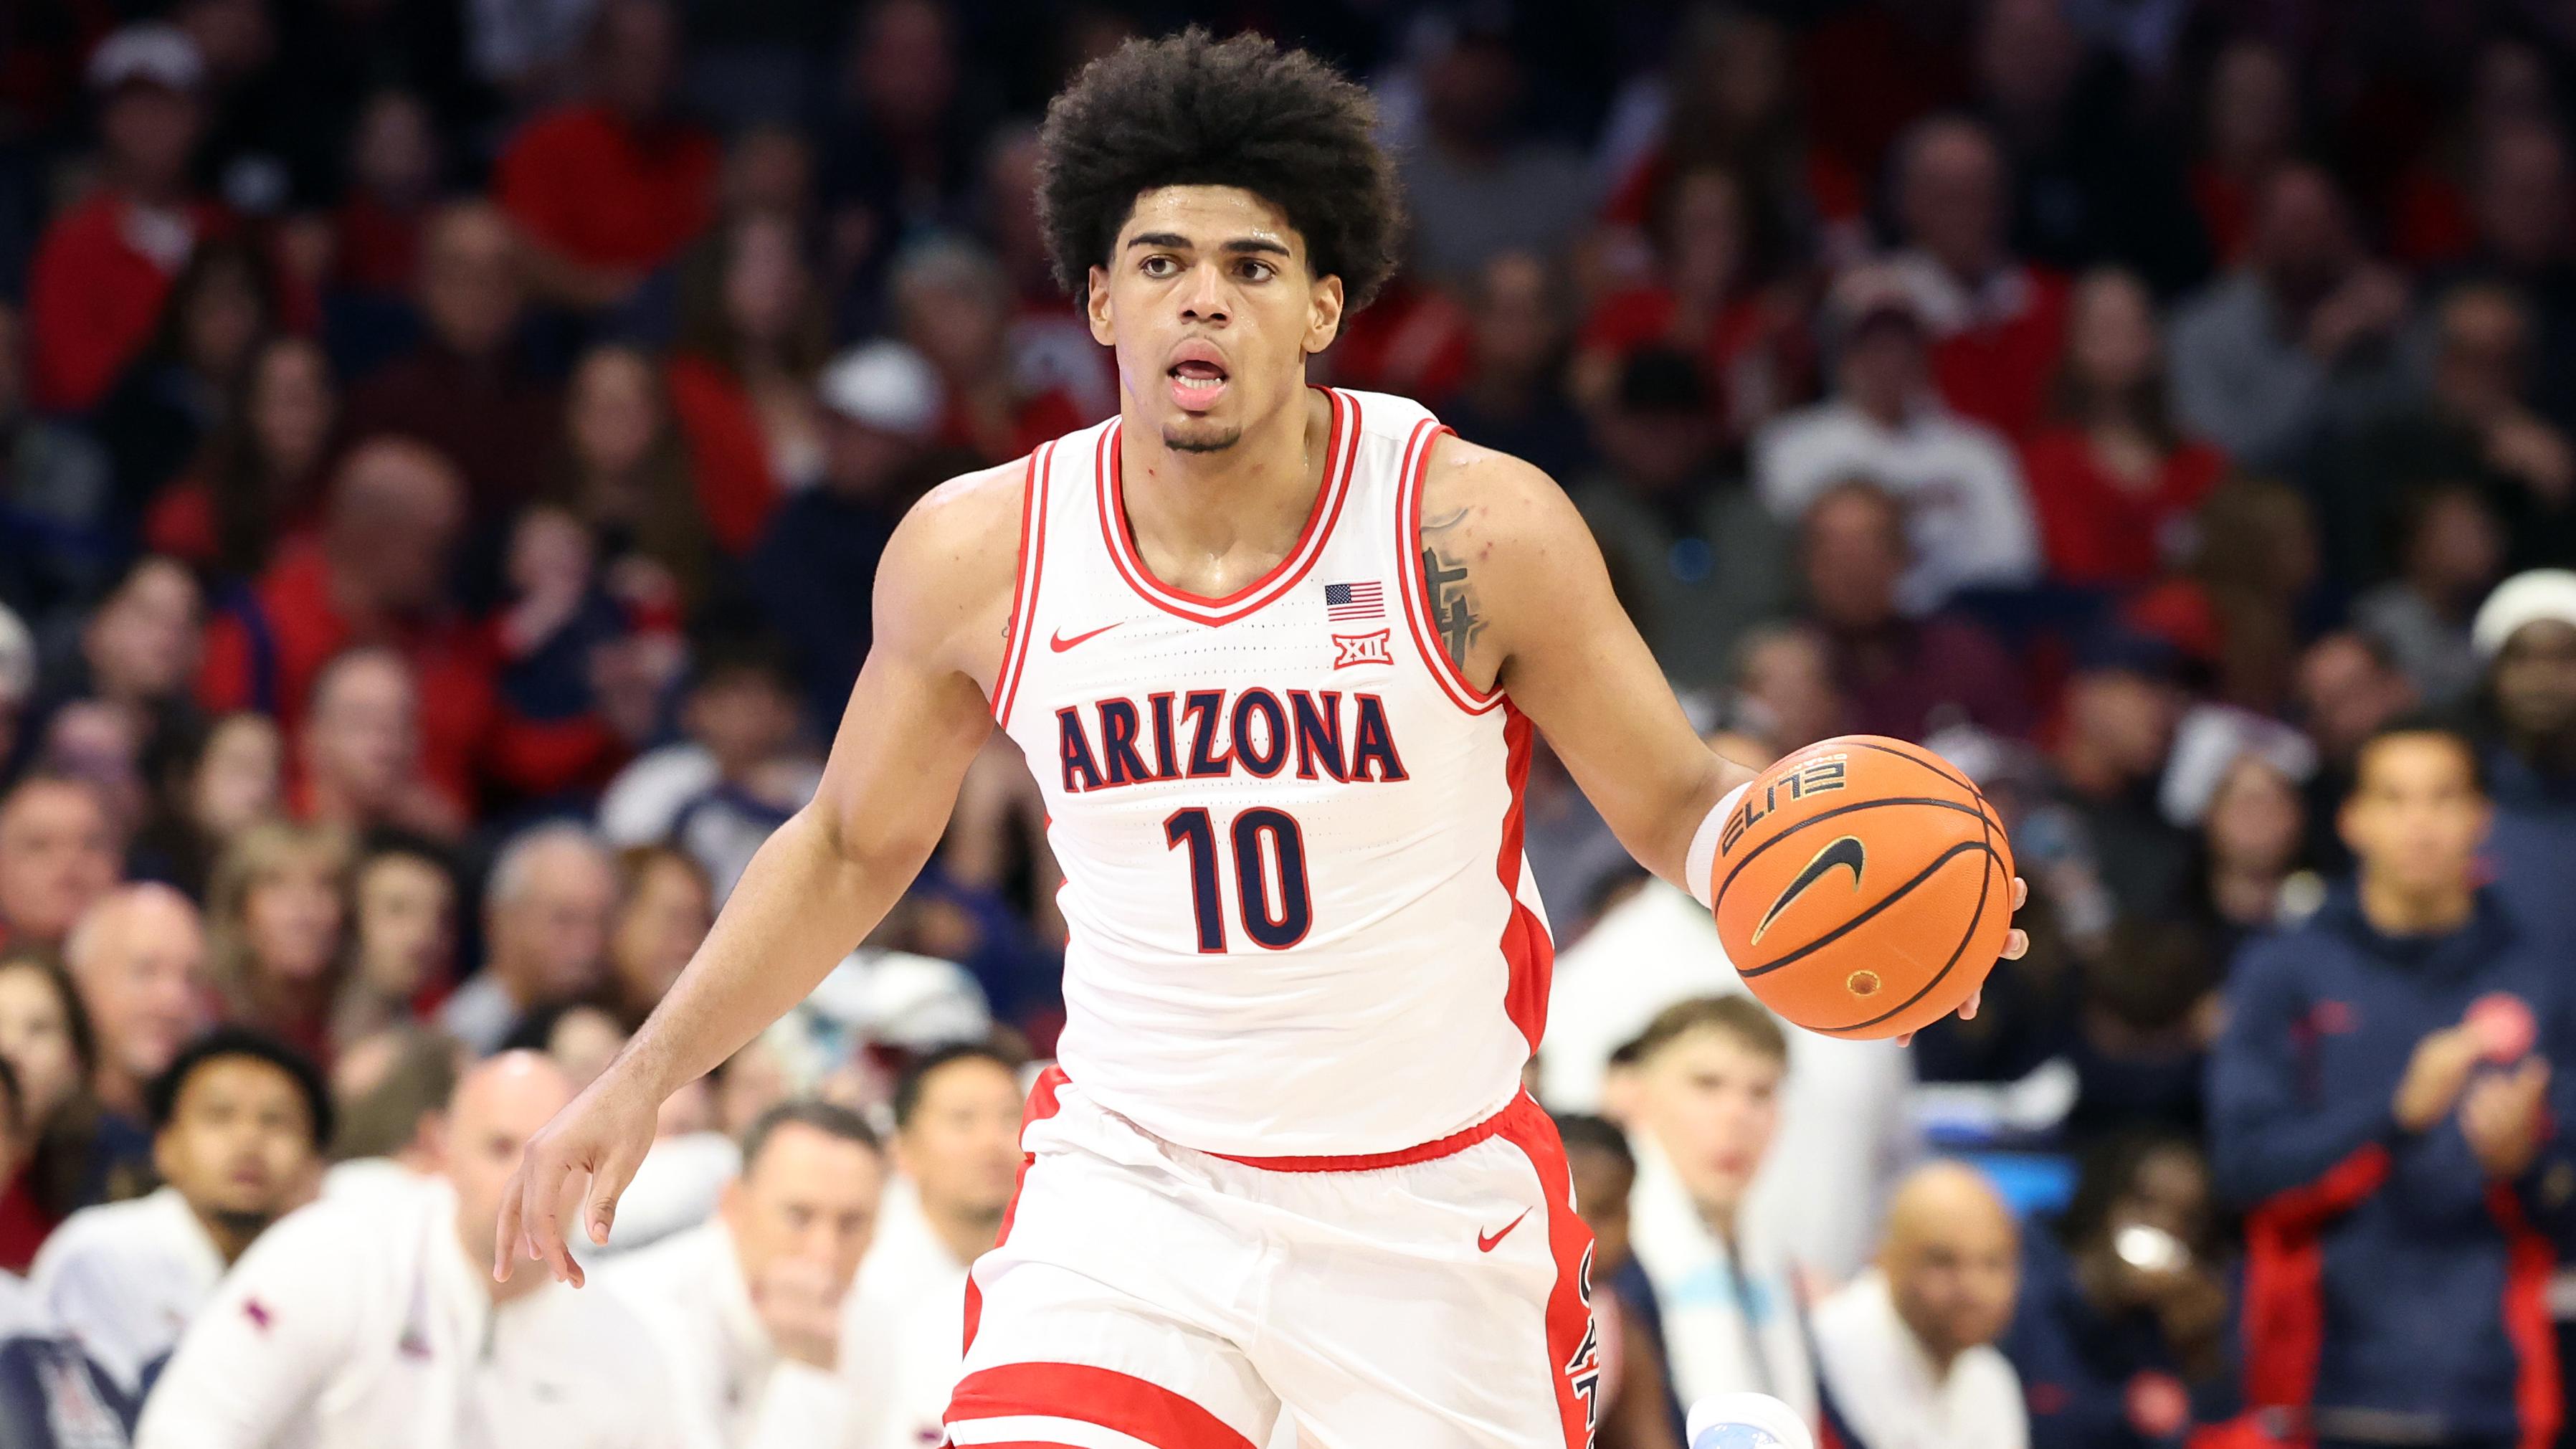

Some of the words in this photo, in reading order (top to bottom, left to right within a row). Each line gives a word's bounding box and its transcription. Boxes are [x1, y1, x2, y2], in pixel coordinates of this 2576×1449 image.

[1332, 629, 1393, 669] XII
[1055, 687, 1410, 793] ARIZONA
[1722, 761, 1847, 857] ELITE
[1162, 807, 1313, 954] 10
